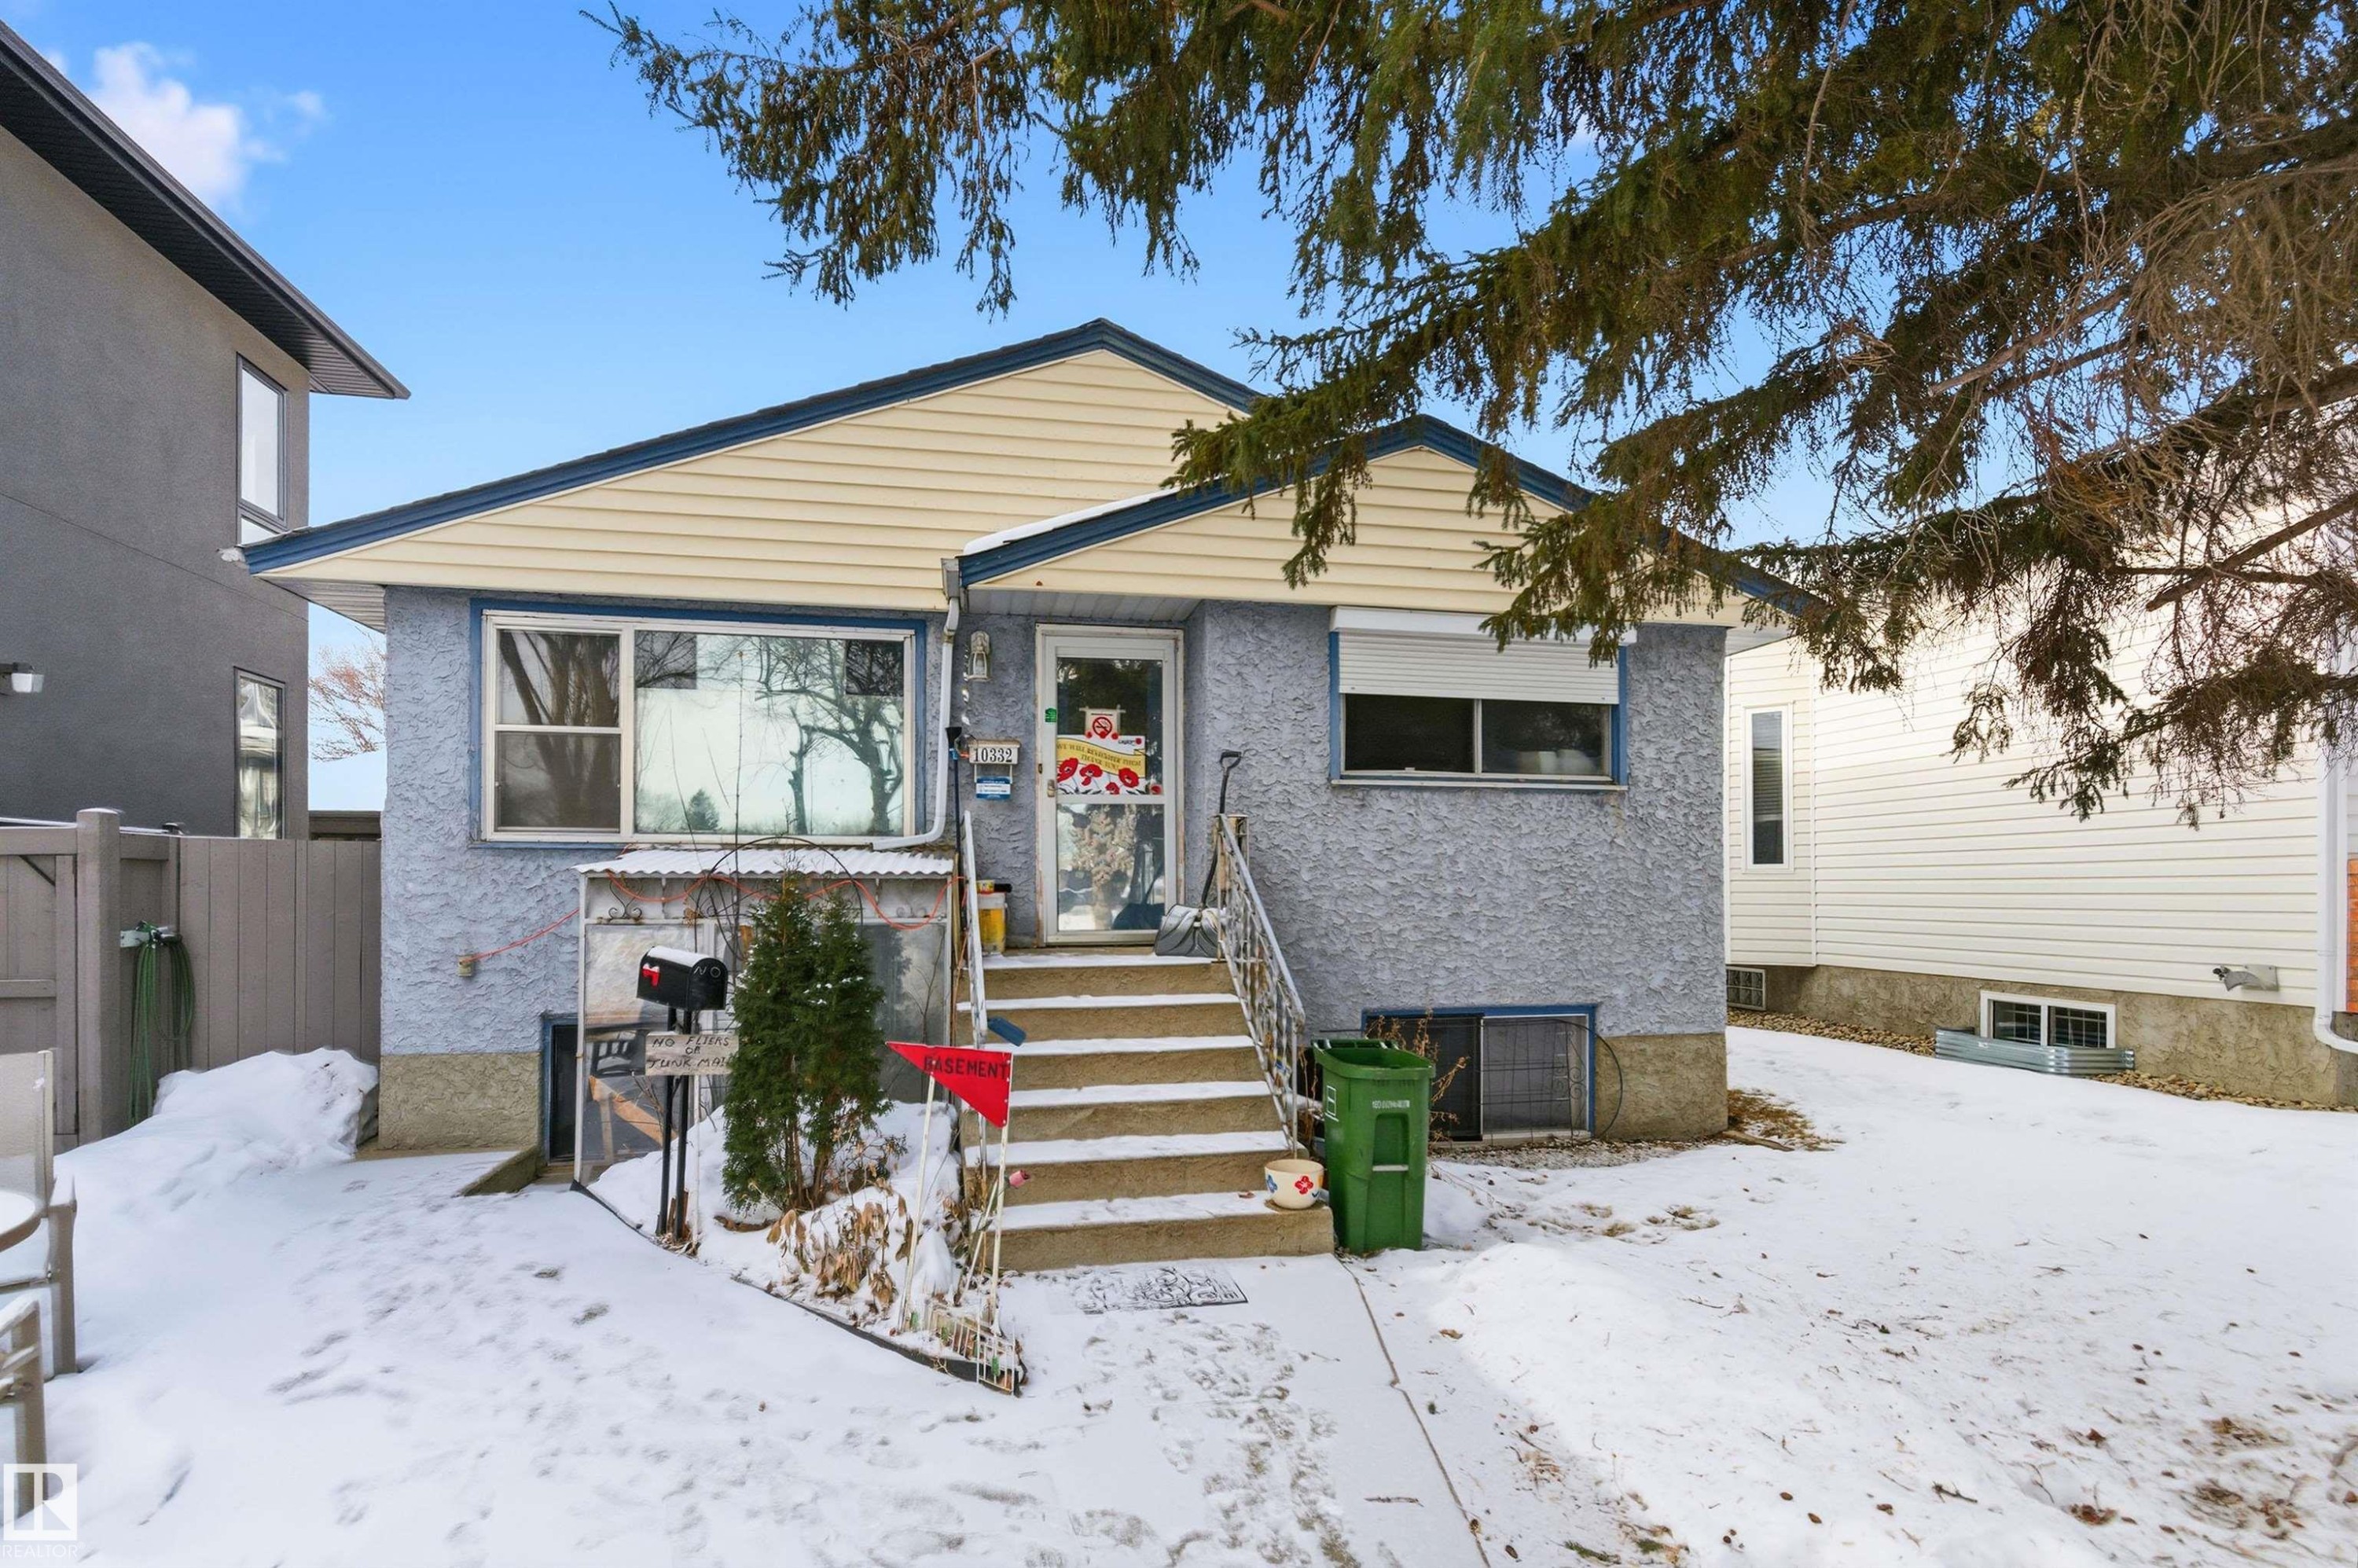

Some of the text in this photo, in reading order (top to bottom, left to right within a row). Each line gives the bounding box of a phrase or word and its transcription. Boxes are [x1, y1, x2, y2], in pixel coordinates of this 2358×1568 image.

[974, 747, 1012, 763] 10332
[693, 965, 722, 979] NO
[652, 1034, 729, 1048] NO FLIERS
[685, 1045, 701, 1056] OR
[647, 1057, 692, 1069] JUNK
[924, 1056, 1007, 1079] BASEMENT
